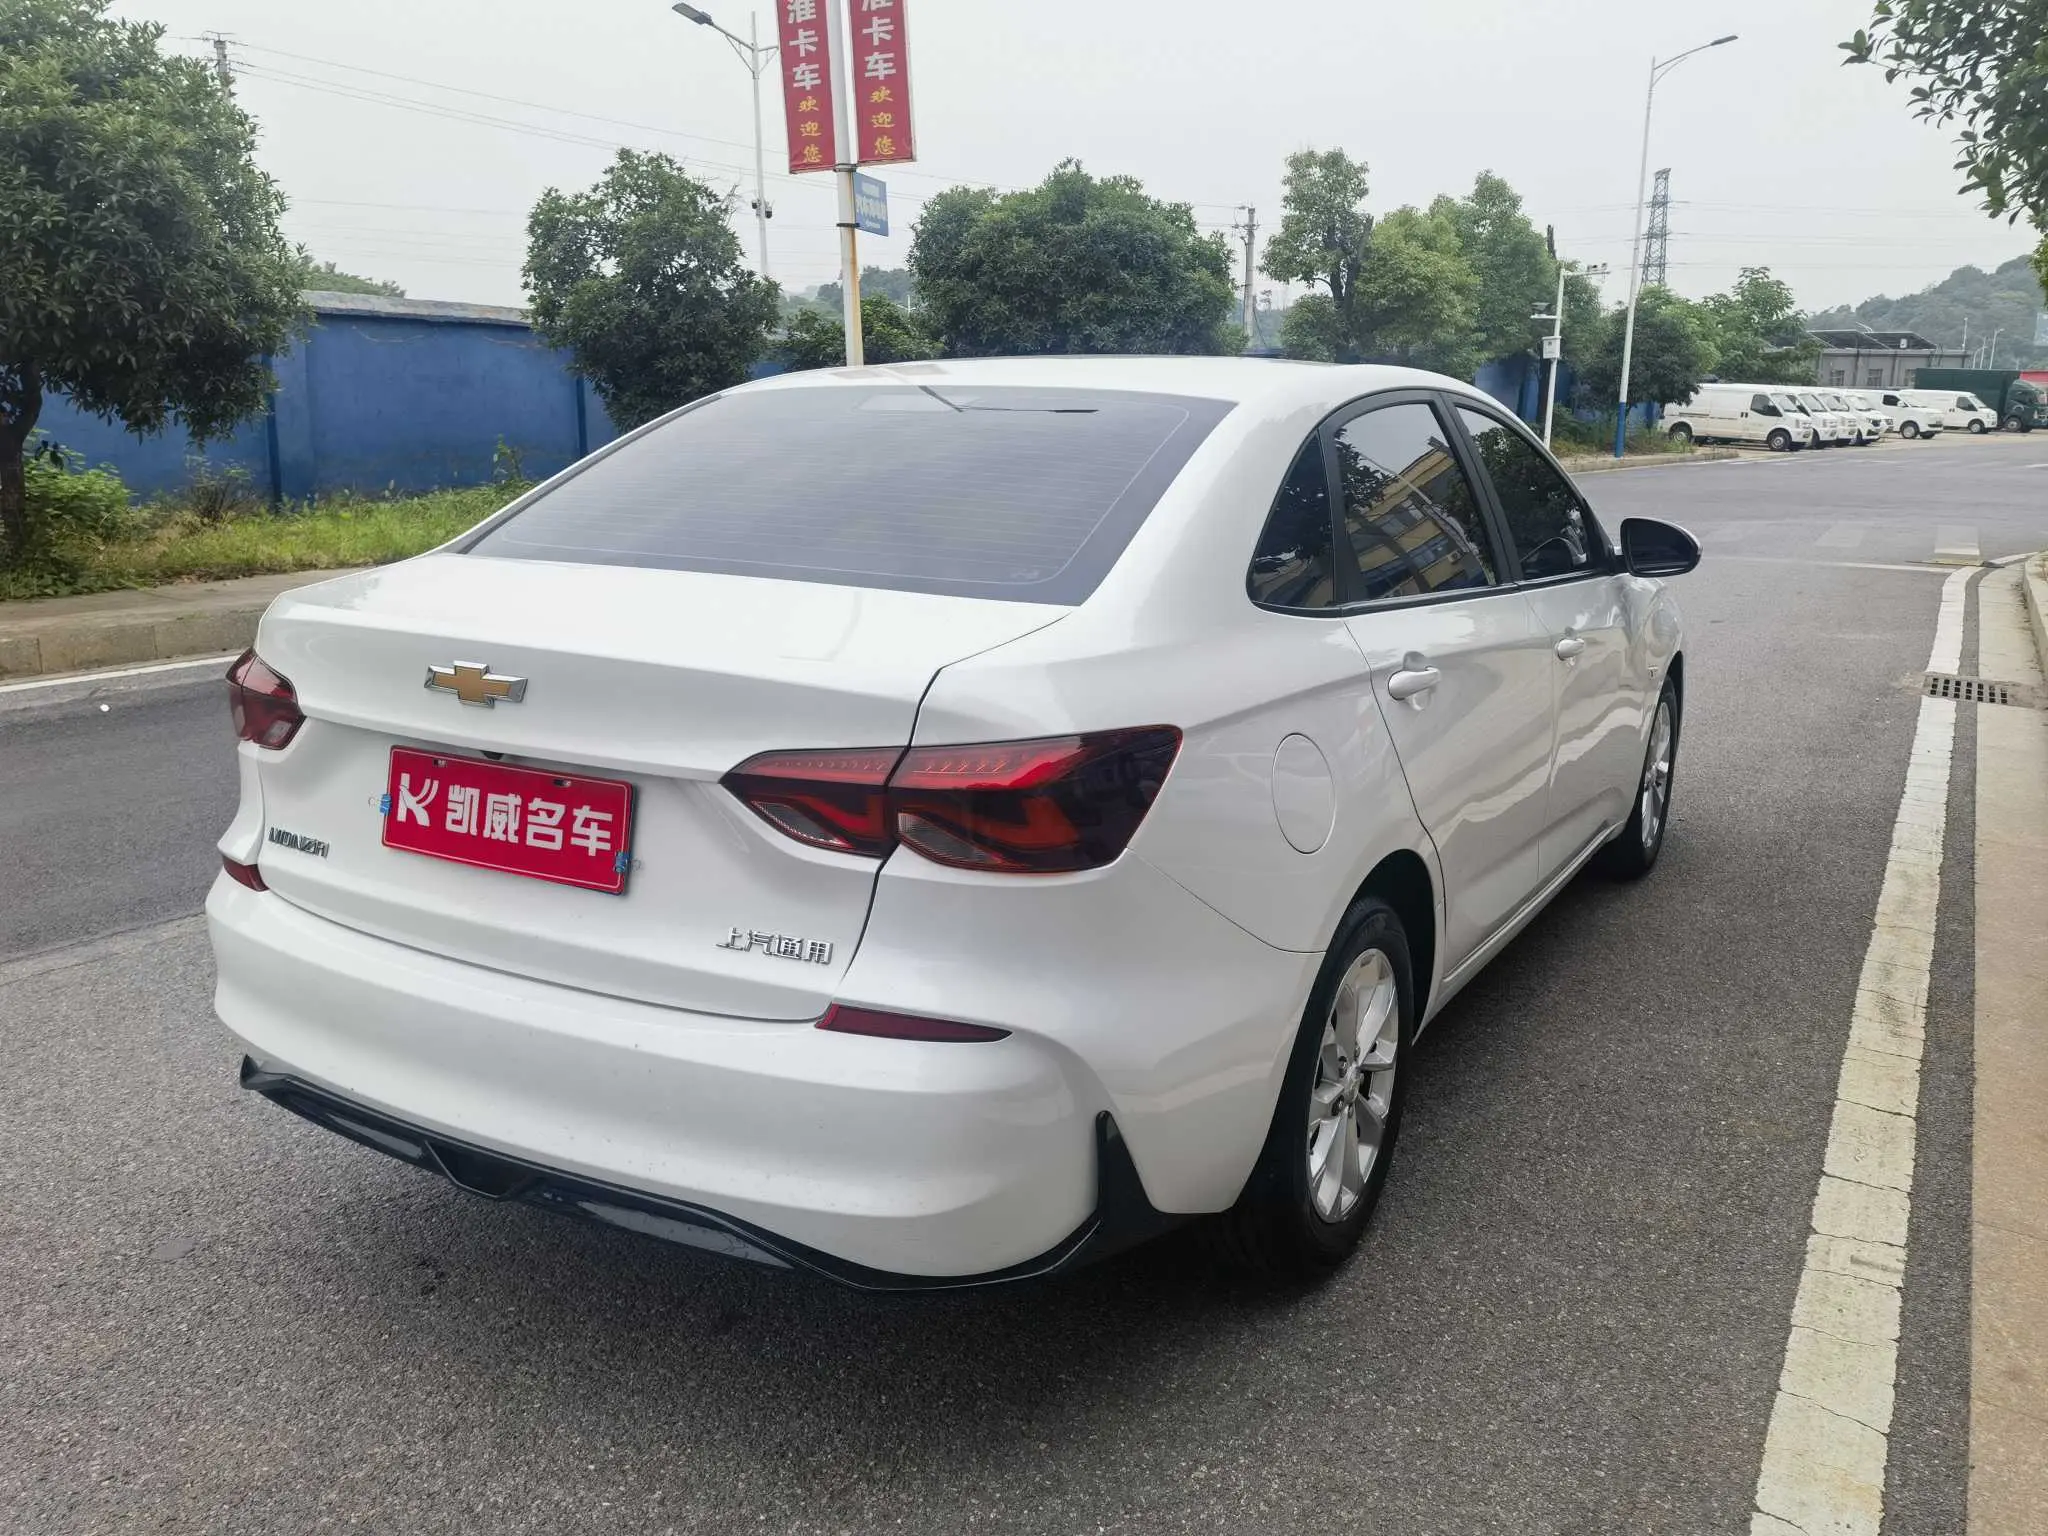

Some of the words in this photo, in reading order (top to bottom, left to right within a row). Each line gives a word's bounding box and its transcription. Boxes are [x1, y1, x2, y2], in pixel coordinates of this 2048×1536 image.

[798, 96, 822, 163] 欢迎您
[870, 86, 896, 156] 欢迎您
[445, 784, 613, 857] 凯威名车
[715, 927, 834, 965] 上汽通用
